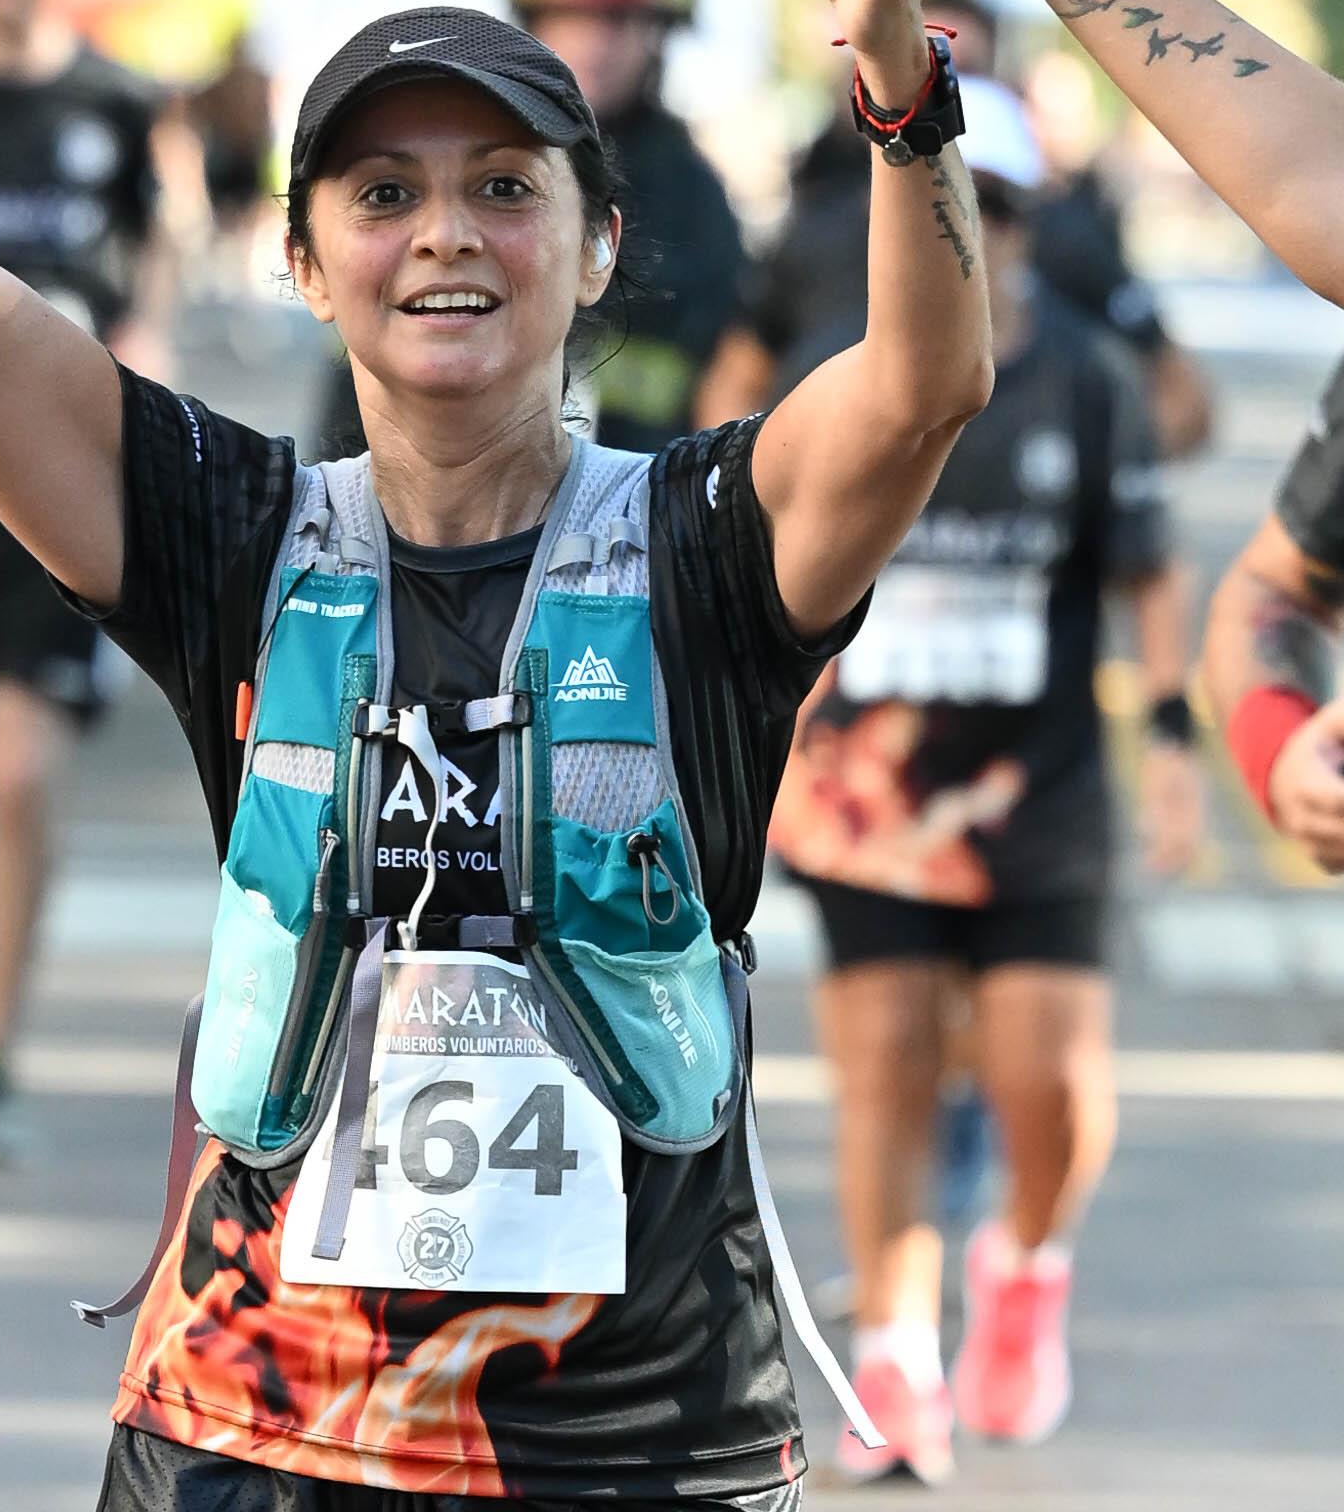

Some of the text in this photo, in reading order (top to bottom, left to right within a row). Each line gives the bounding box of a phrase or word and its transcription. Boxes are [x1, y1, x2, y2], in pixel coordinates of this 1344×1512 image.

[554, 687, 627, 702] AONIJIE
[456, 850, 503, 871] VOL
[376, 1035, 546, 1055] OMBEROS VOLUNTARIOS
[419, 1231, 451, 1260] 27
